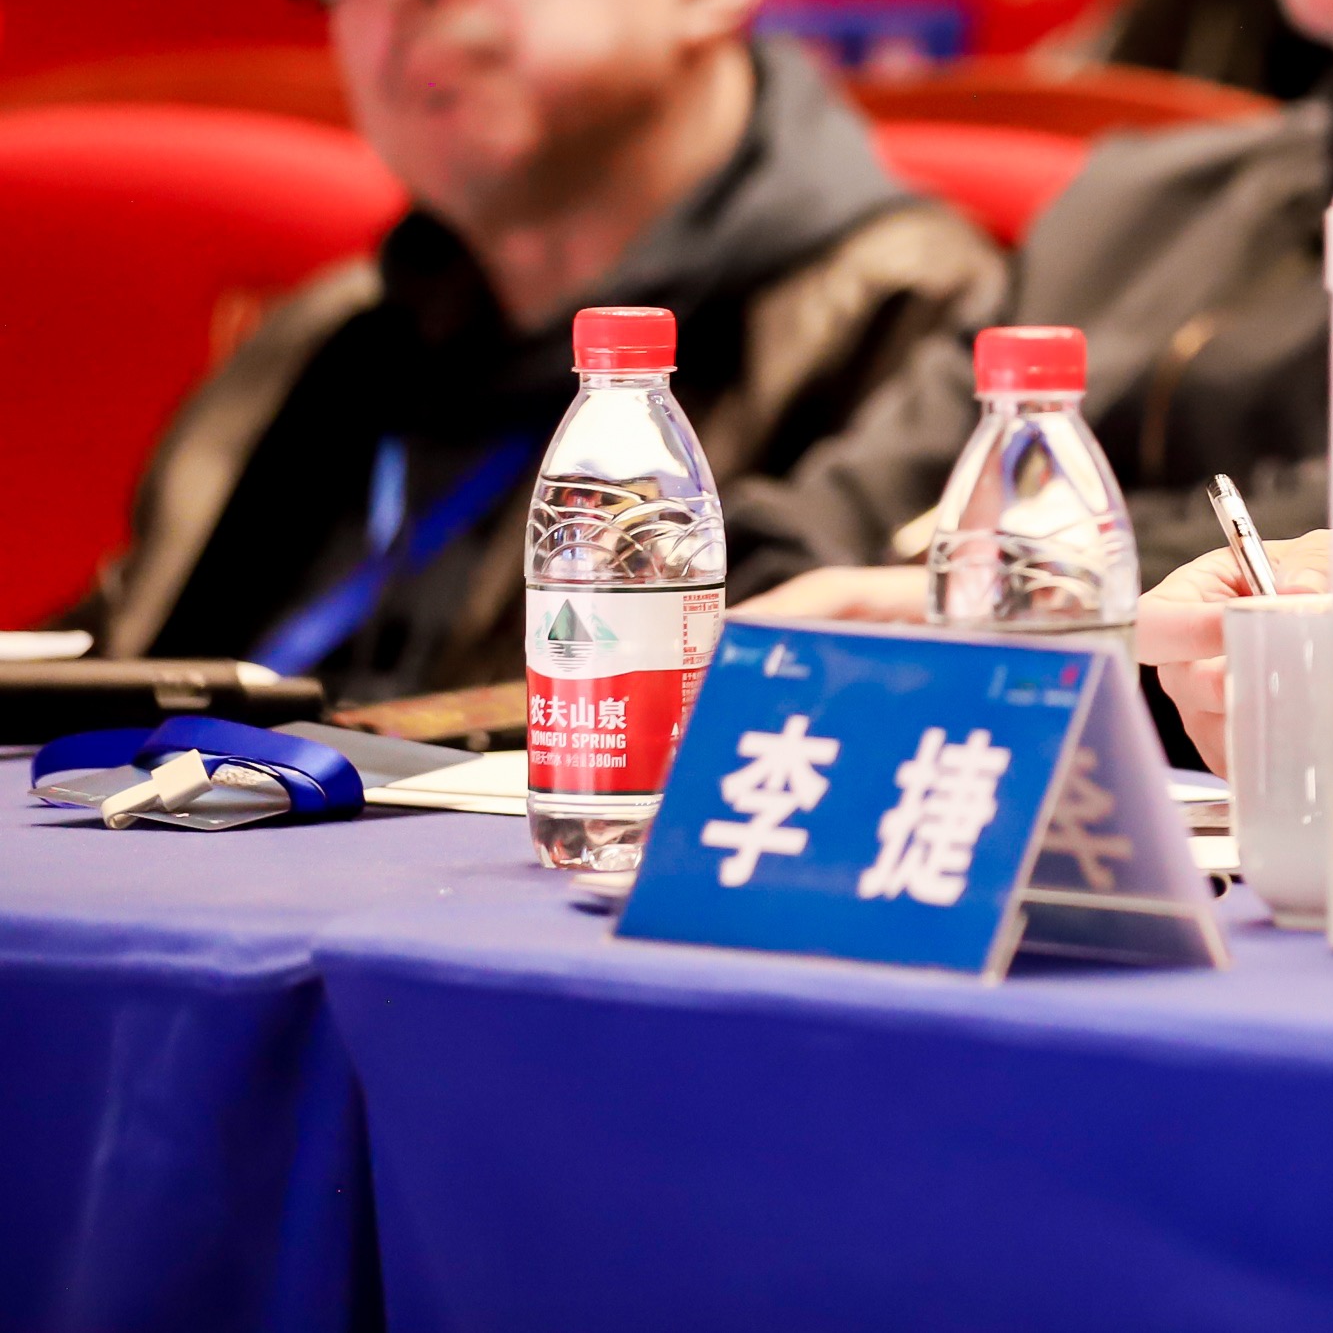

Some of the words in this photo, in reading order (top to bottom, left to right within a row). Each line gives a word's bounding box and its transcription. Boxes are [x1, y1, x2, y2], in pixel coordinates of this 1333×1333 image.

[531, 694, 627, 730] 农夫山泉
[571, 732, 627, 749] SPRING
[588, 753, 627, 768] 380ml
